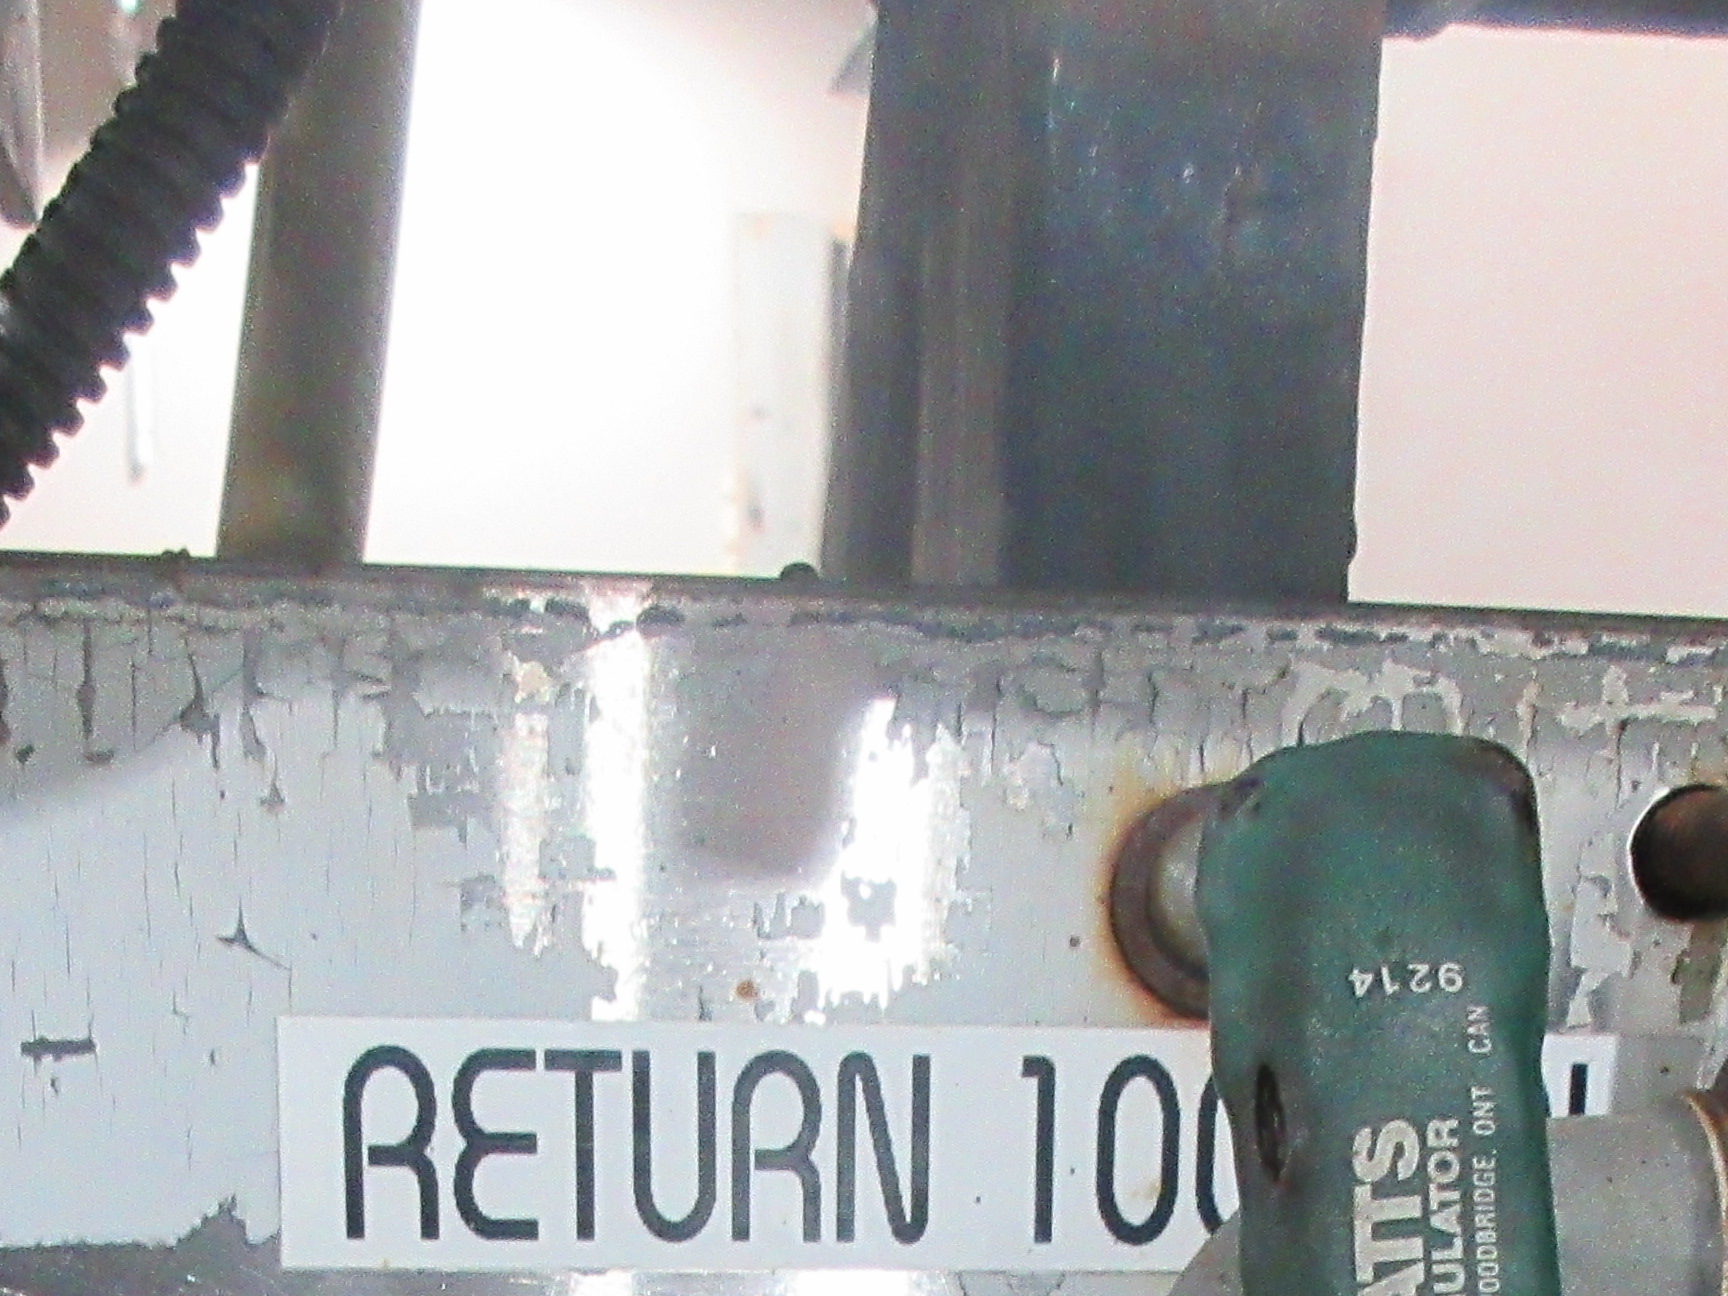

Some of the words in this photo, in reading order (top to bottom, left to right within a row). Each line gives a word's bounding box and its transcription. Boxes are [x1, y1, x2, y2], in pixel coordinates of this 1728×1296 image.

[1347, 962, 1464, 998] 9214
[1466, 1004, 1494, 1055] CAN
[1471, 1085, 1497, 1137] ONT
[342, 1044, 931, 1244] RETURN
